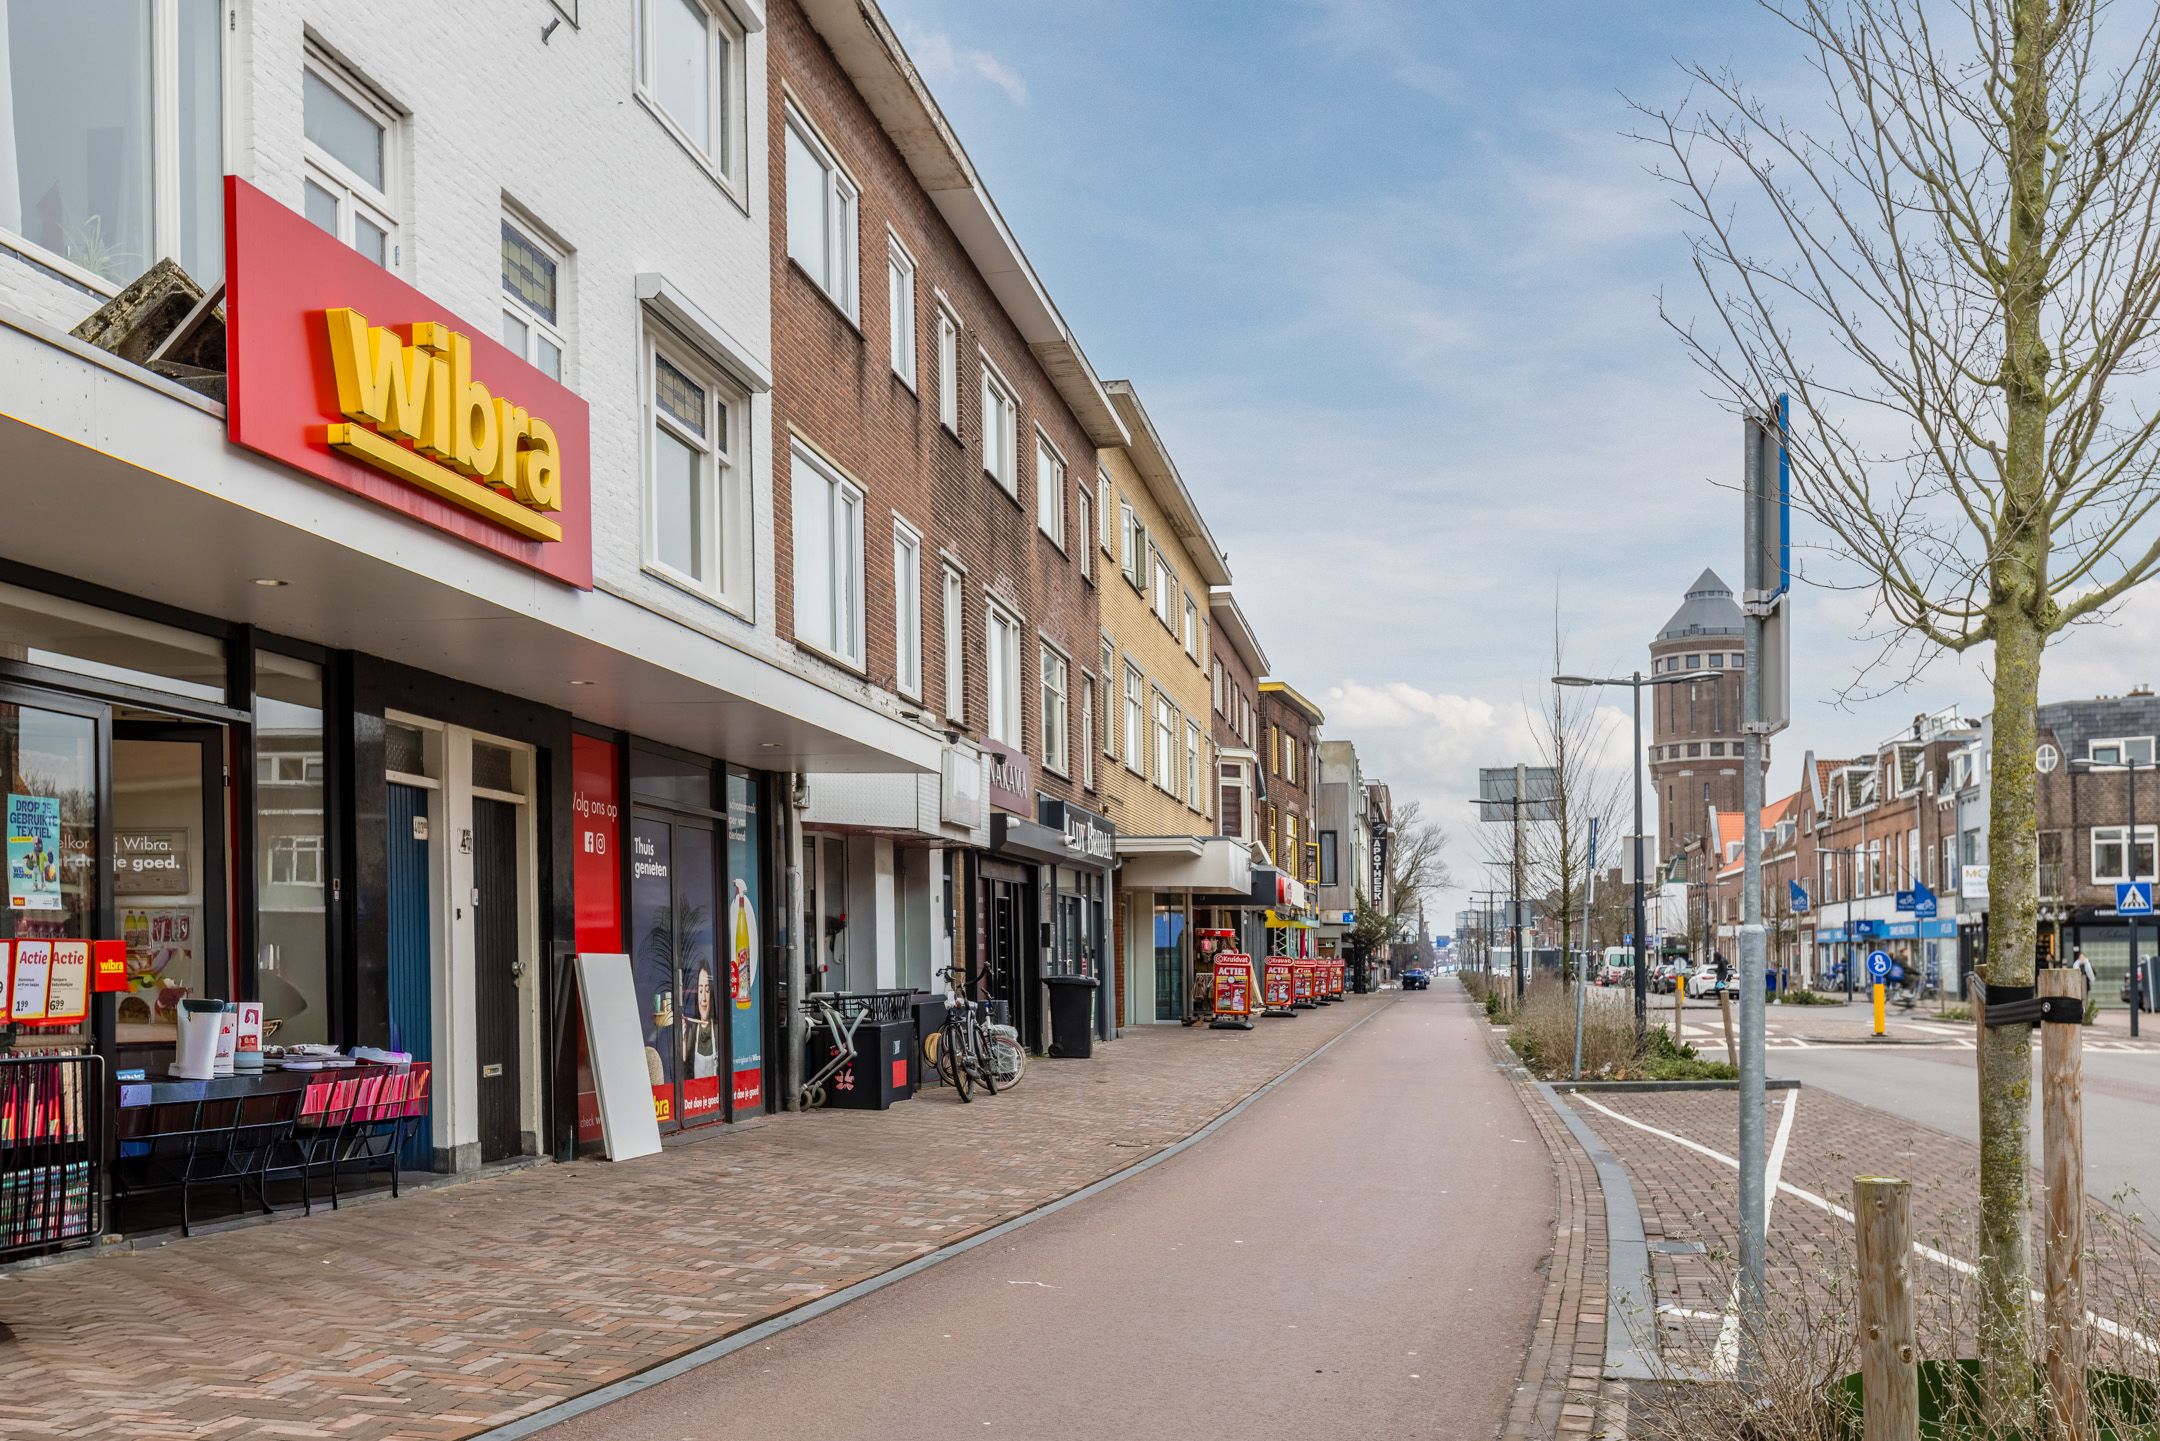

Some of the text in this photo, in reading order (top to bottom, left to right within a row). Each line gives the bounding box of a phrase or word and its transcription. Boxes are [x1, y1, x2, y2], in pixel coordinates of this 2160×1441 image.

[326, 306, 563, 512] wibra
[990, 756, 1028, 799] NAKAMA
[15, 800, 40, 812] DROP
[592, 801, 605, 815] ons
[607, 805, 618, 823] op
[9, 812, 58, 827] GEBRUIKTE
[16, 825, 51, 839] TEXTIEL
[123, 836, 172, 851] Wibra.
[634, 836, 654, 856] Thuis
[113, 854, 127, 872] je
[132, 855, 181, 872] goed.
[635, 858, 667, 879] genieten
[1373, 840, 1382, 900] APOTHEEK
[19, 950, 48, 965] Actie
[53, 951, 84, 965] Actie
[1223, 955, 1249, 963] Kruidvat
[100, 959, 124, 973] wibra
[1218, 967, 1246, 976] ACTIE!
[653, 1095, 670, 1117] bra
[684, 1099, 693, 1110] Dat
[694, 1097, 703, 1109] doe
[703, 1096, 708, 1110] je
[708, 1093, 719, 1109] goed
[580, 1114, 595, 1128] check
